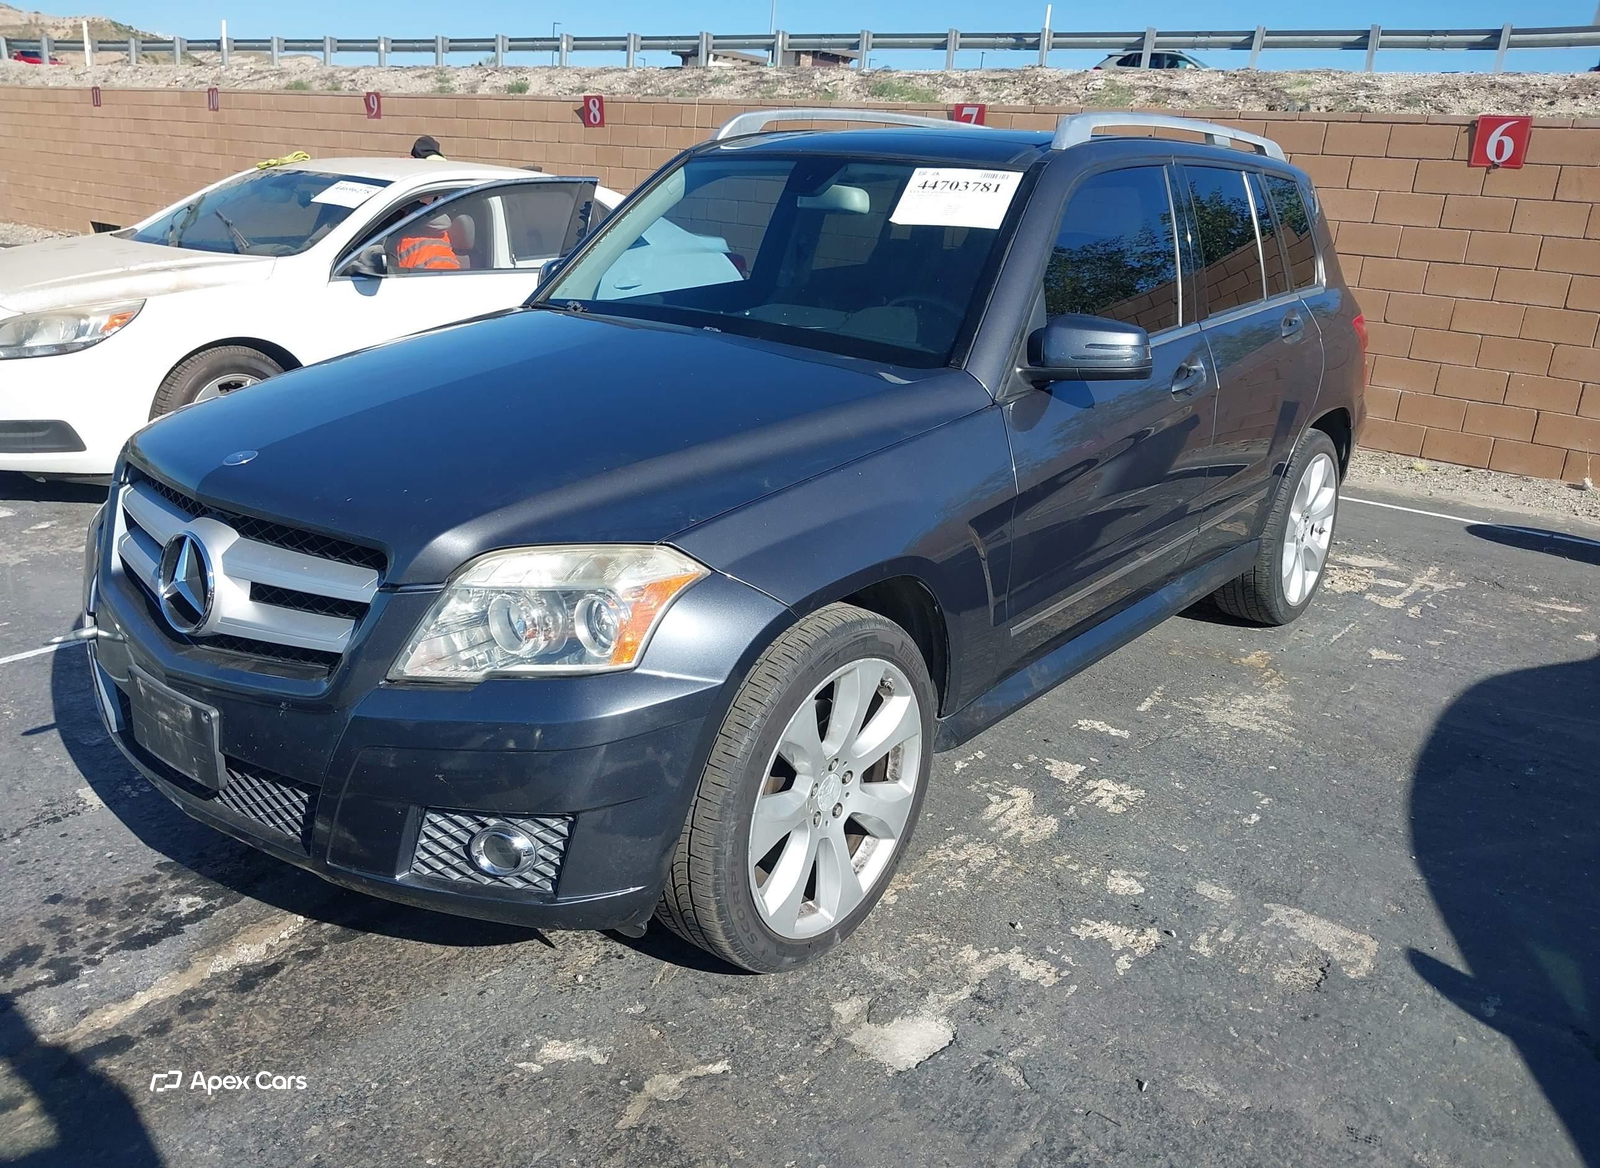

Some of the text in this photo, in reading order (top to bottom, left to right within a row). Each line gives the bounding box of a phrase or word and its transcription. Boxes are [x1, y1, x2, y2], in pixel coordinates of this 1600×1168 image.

[93, 88, 100, 105] 11
[209, 89, 218, 110] 10
[370, 94, 378, 116] 9
[589, 98, 601, 124] 8
[961, 107, 979, 124] 7
[1486, 120, 1520, 163] 6
[917, 180, 1001, 193] 44703781
[730, 814, 759, 945] SCORPION
